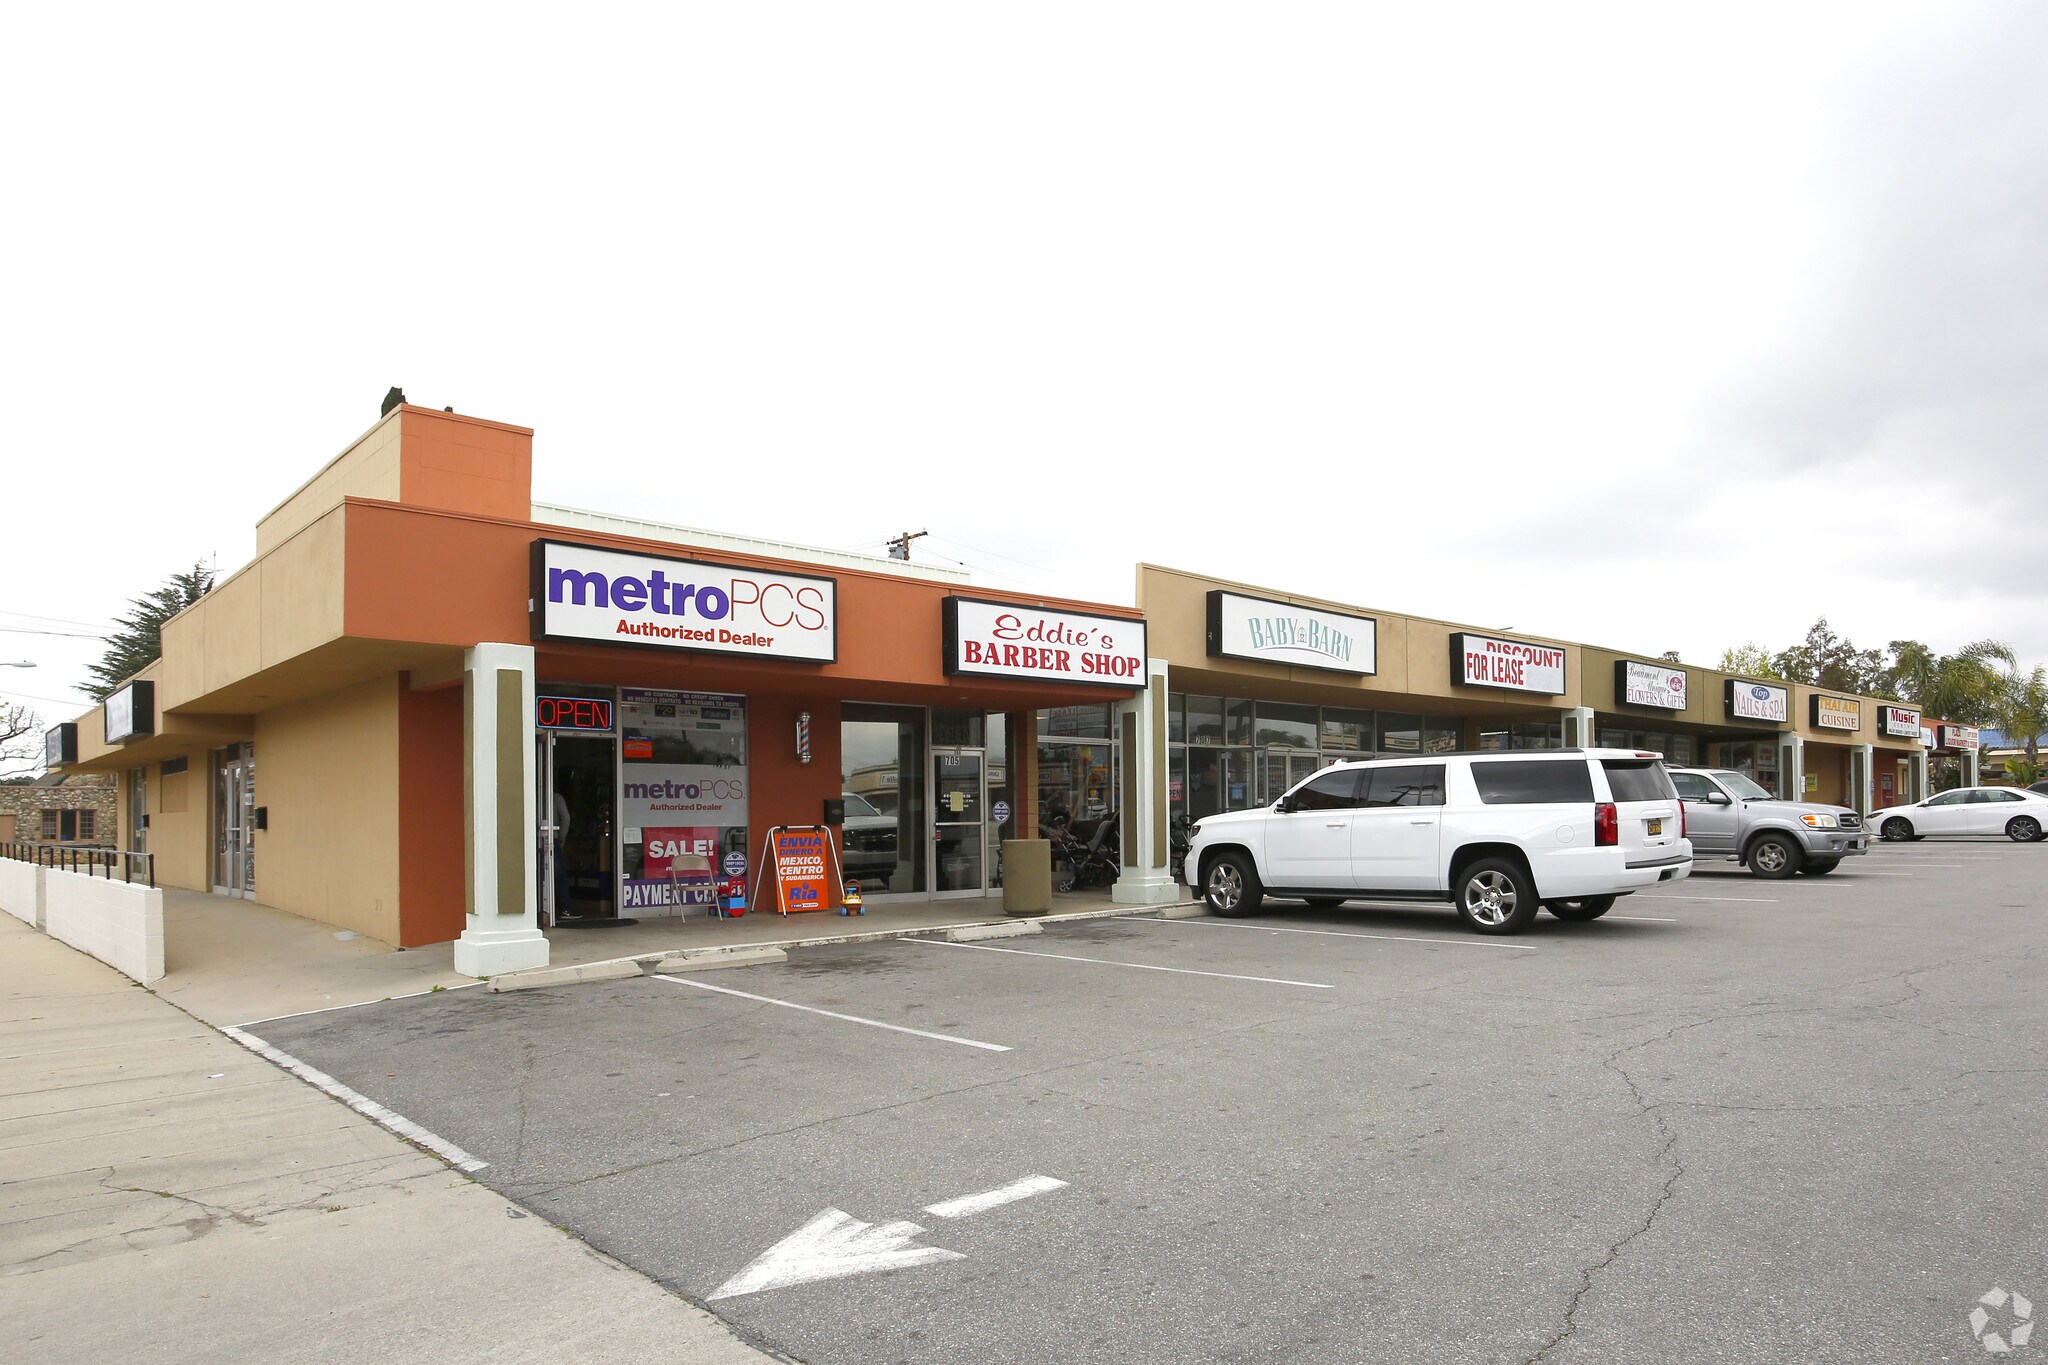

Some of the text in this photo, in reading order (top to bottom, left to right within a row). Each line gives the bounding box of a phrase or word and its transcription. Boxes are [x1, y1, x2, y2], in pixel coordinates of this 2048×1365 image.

[549, 567, 826, 631] metroPCS
[616, 619, 774, 648] Authorized Dealer
[992, 613, 1114, 650] Eddie's
[1247, 617, 1354, 663] BABY BARN
[964, 640, 1141, 677] BARBER SHOP
[1466, 652, 1524, 685] FOR LEASE
[1627, 688, 1658, 705] FLOWERS
[1667, 694, 1685, 709] GIFTS
[1753, 687, 1768, 700] Top
[1734, 688, 1785, 720] NAILS & SPA
[539, 698, 609, 729] OPEN
[1821, 713, 1857, 728] CUISINE
[1891, 708, 1915, 724] Music
[945, 756, 960, 766] 705
[624, 779, 744, 800] metroPCS
[650, 803, 723, 811] Authorized Dealer
[648, 840, 714, 858] SALE!
[778, 836, 823, 847] ENVIA
[779, 848, 814, 856] DINERO
[780, 856, 823, 866] MEXICO,
[779, 865, 824, 875] CENTRO
[789, 882, 818, 900] Ria
